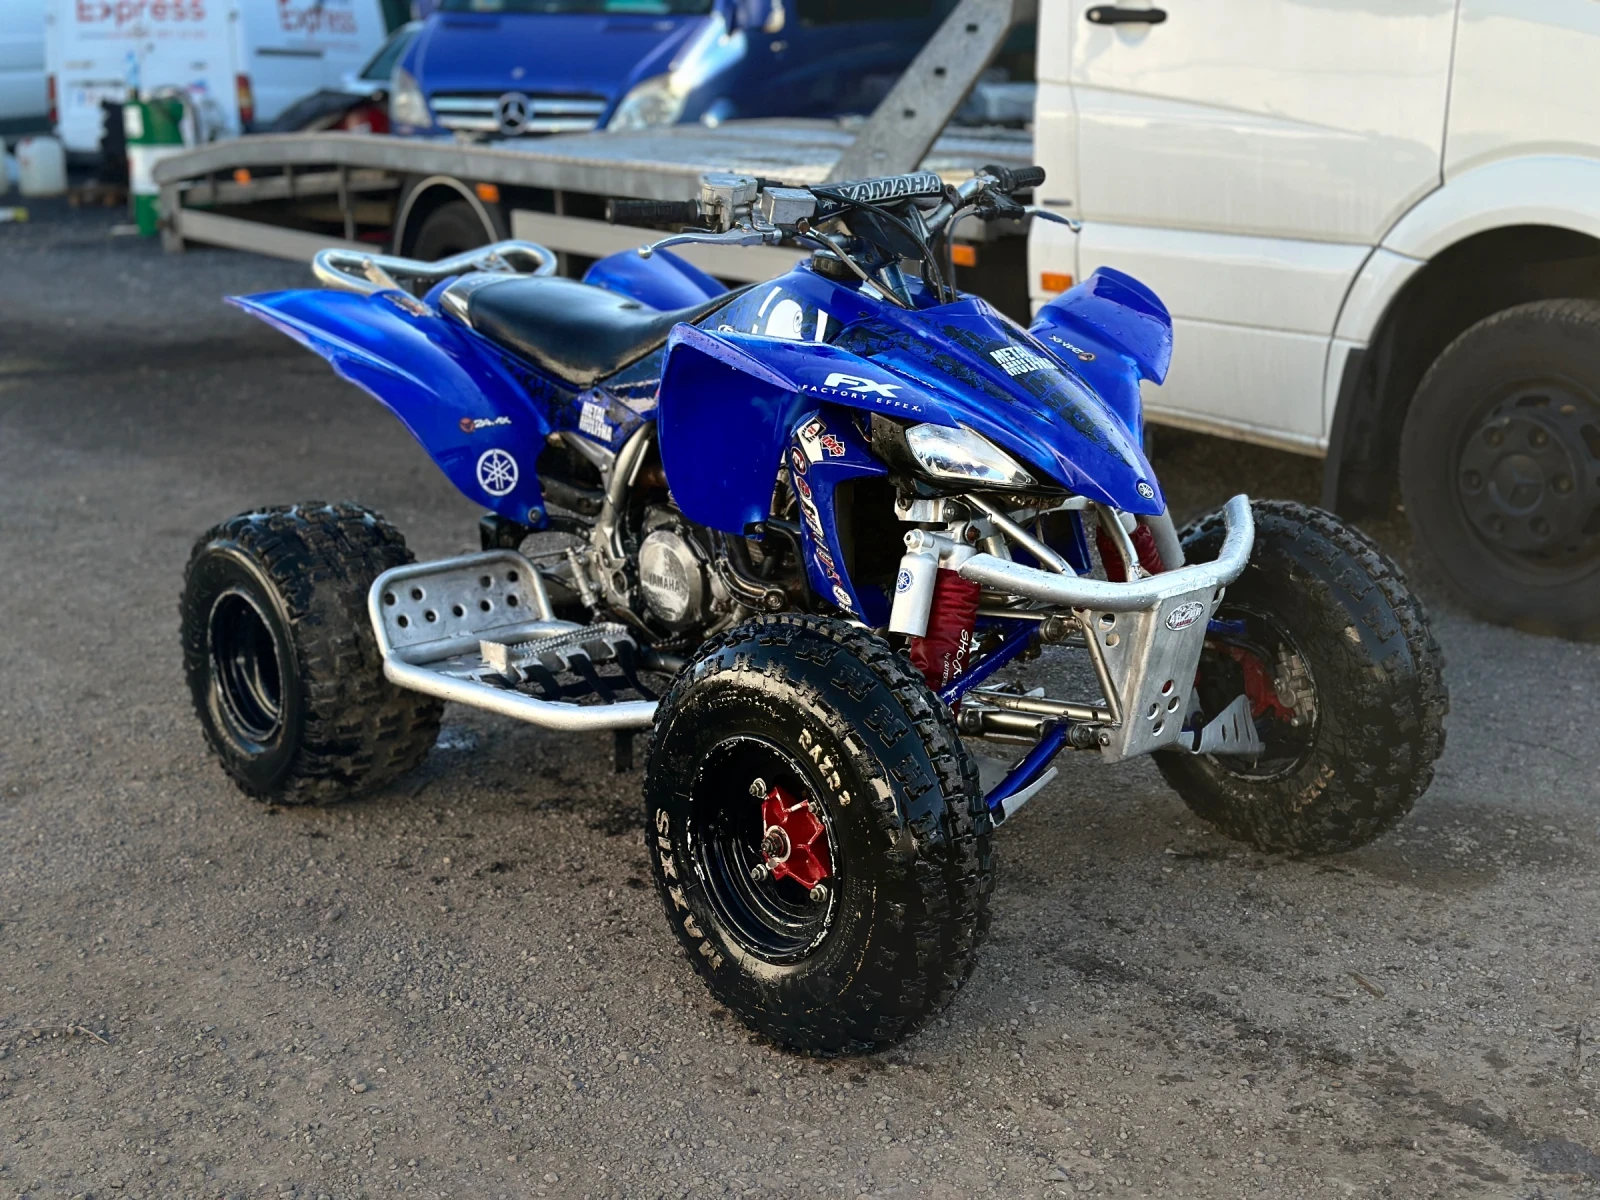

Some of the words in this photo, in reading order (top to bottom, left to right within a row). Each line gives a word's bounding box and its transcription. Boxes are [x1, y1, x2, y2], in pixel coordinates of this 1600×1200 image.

[76, 0, 206, 27] Express
[838, 173, 941, 207] YAMAHA
[989, 345, 1034, 364] METAL
[802, 384, 868, 401] FACTORY
[875, 397, 919, 412] EFFEX
[823, 372, 899, 398] FX
[822, 434, 844, 455] IMS
[648, 573, 680, 592] YAMAHA
[655, 807, 725, 972] MAXXIS
